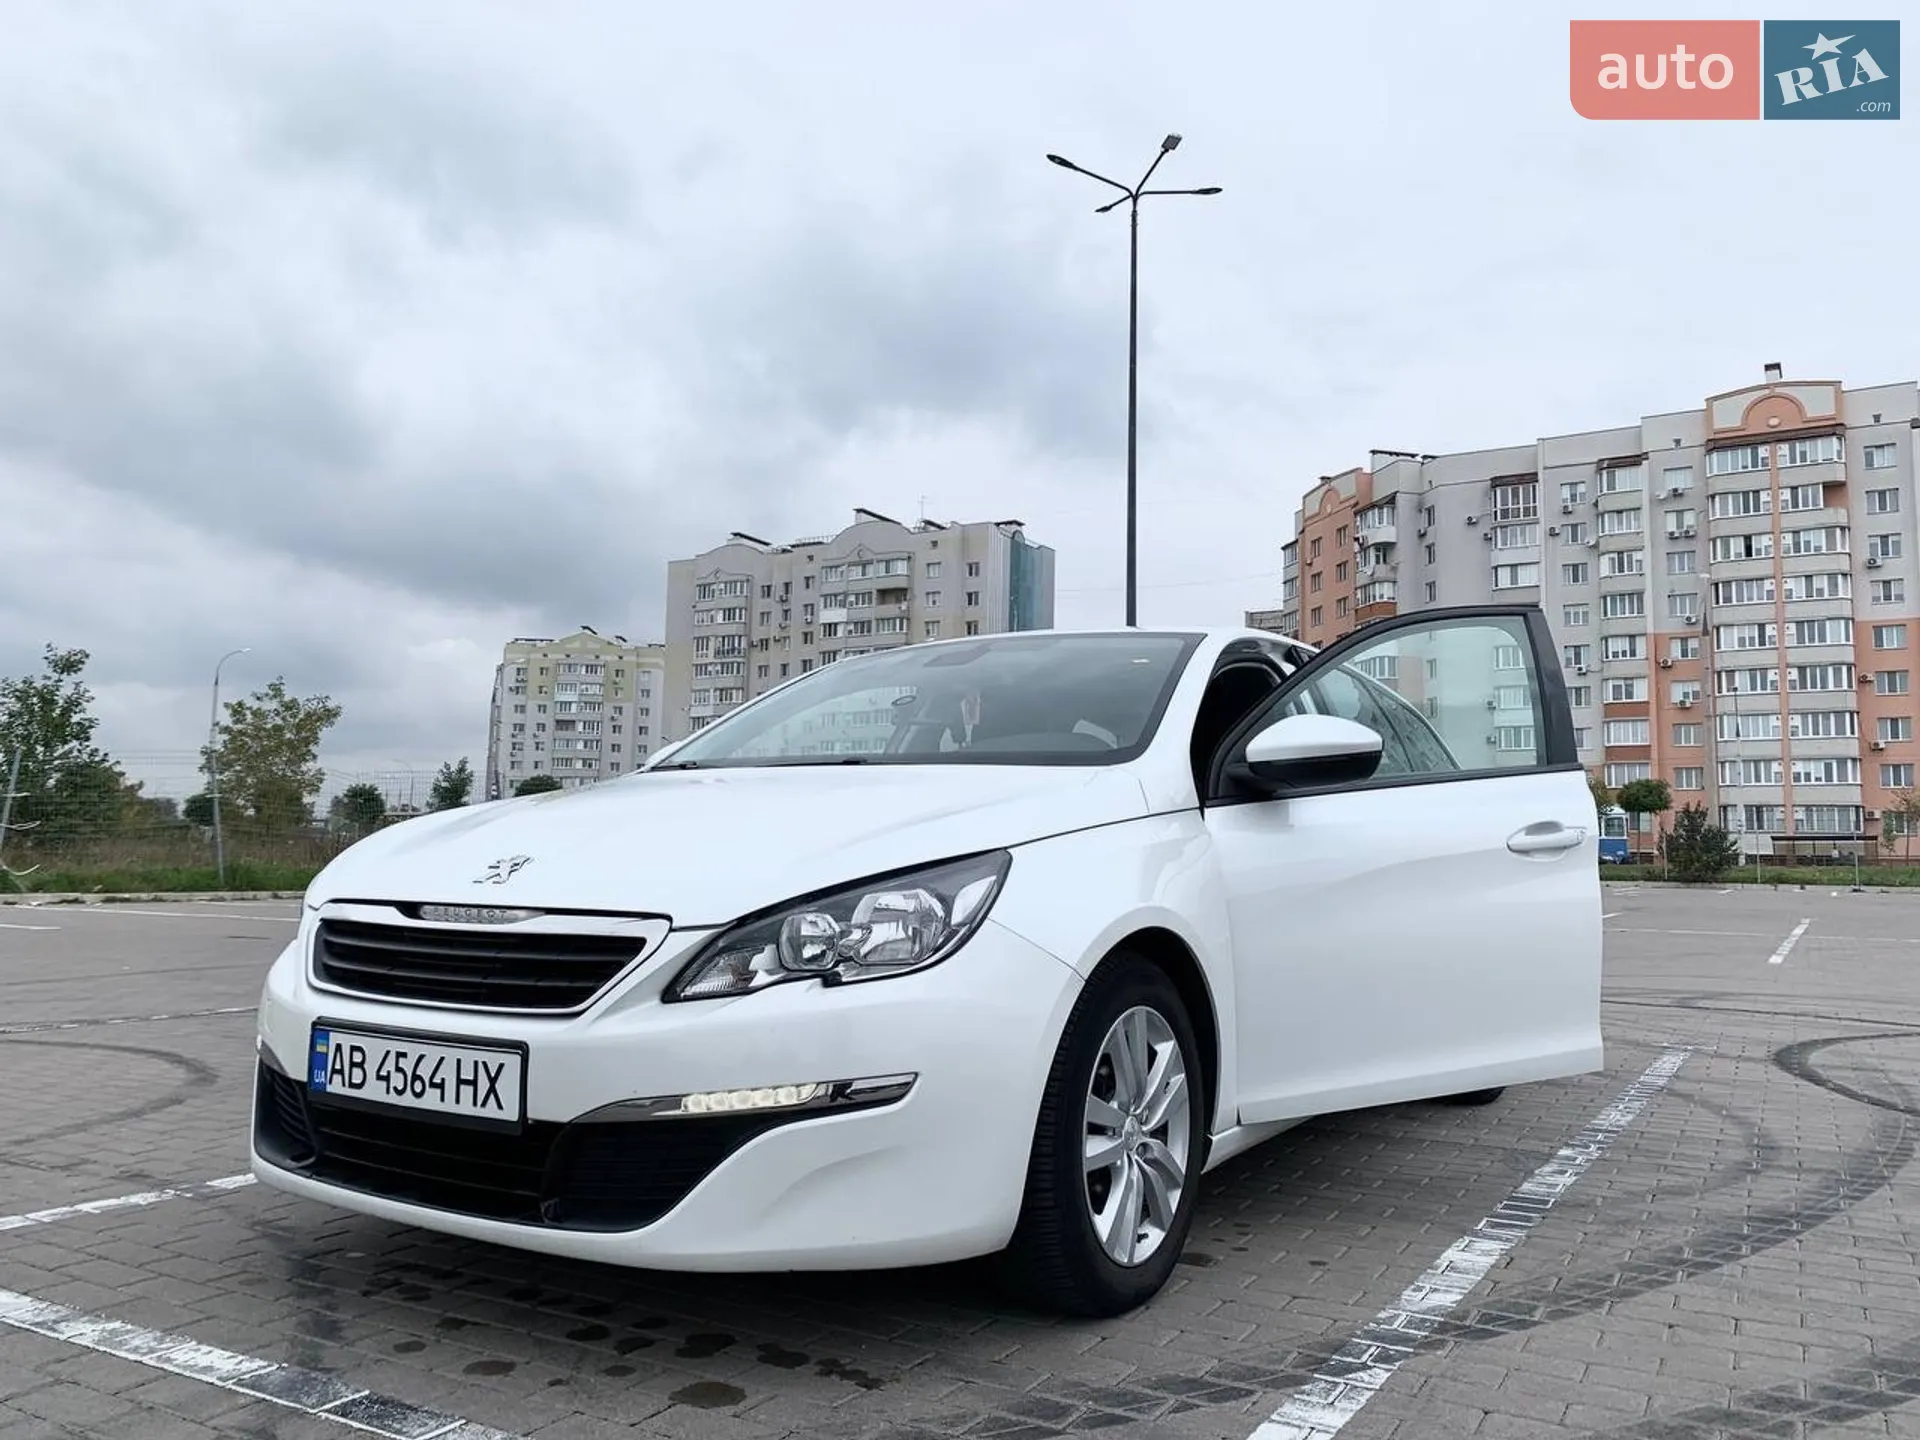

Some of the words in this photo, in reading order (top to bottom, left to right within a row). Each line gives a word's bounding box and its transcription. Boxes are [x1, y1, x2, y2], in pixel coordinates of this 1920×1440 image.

[314, 1069, 326, 1083] UA
[328, 1042, 367, 1090] AB
[375, 1049, 446, 1103] 4564
[455, 1057, 505, 1111] HX
